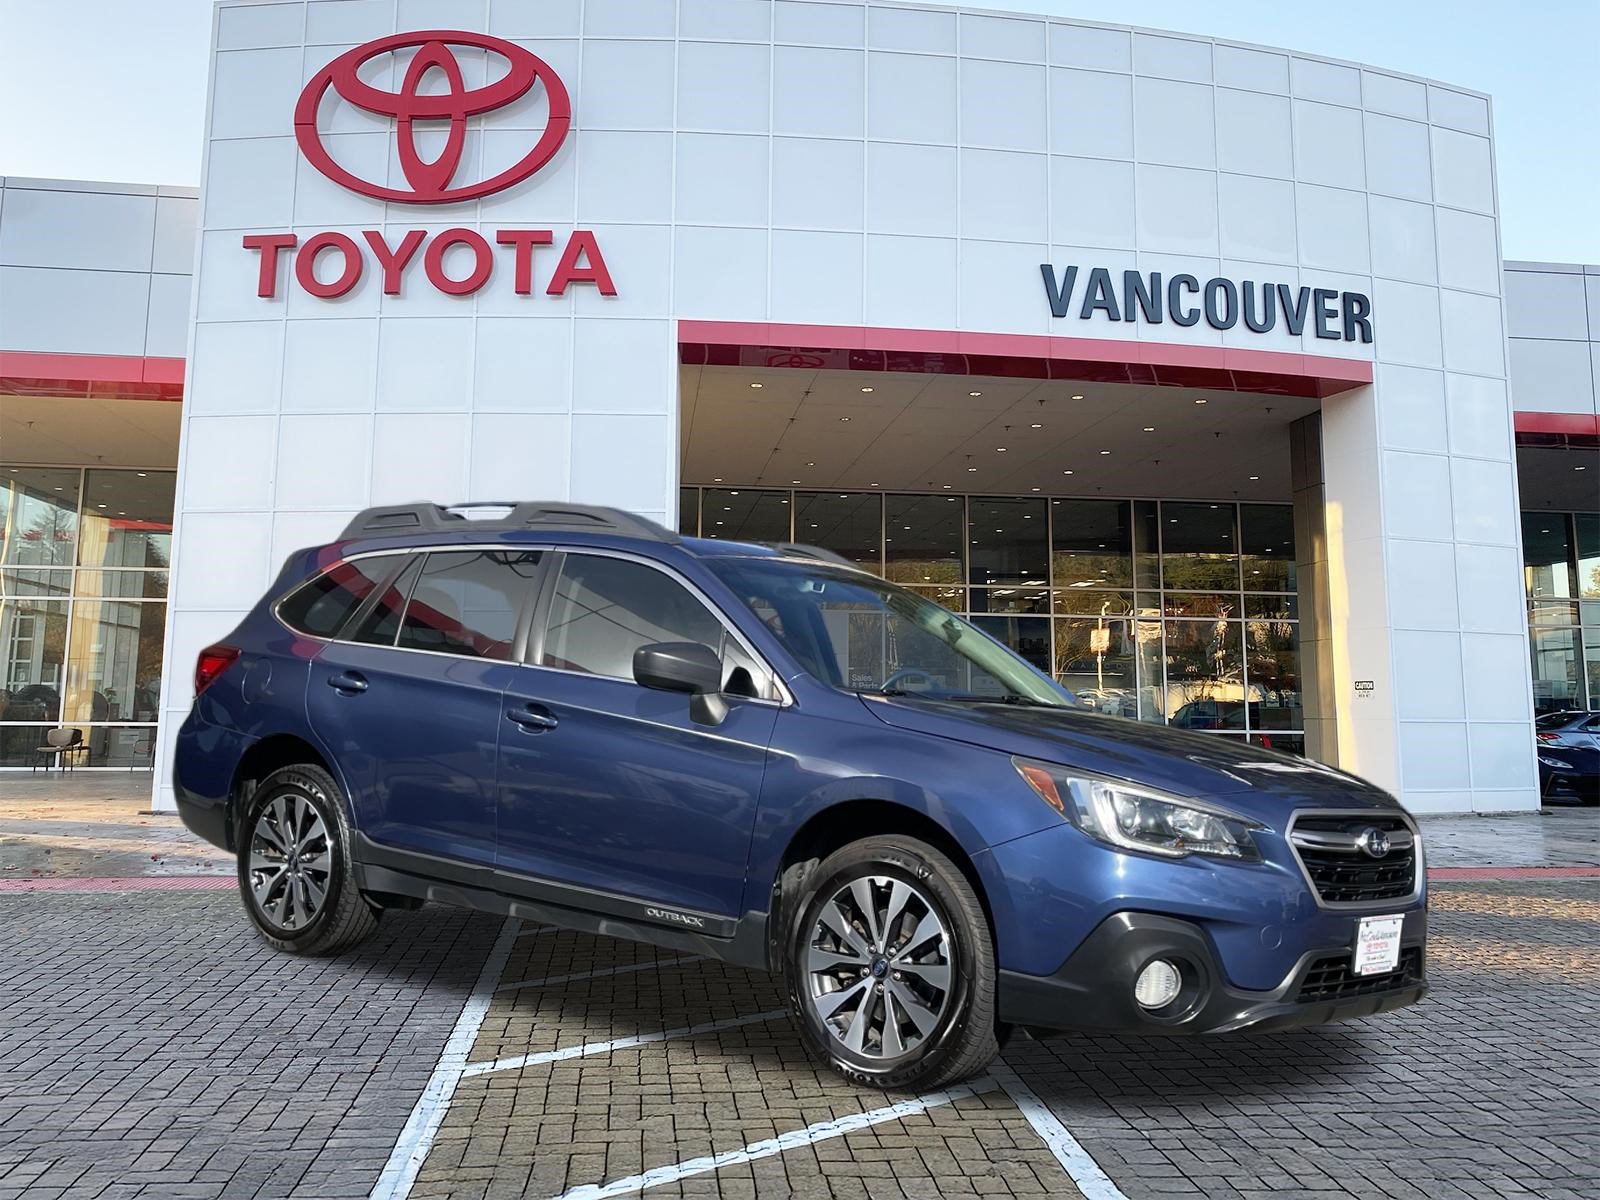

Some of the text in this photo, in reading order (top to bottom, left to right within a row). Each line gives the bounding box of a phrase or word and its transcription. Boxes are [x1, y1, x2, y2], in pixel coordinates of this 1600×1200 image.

[243, 227, 618, 298] TOYOTA
[1040, 263, 1373, 344] VANCOUVER
[851, 673, 872, 682] Sales
[646, 908, 703, 927] OUTBACK
